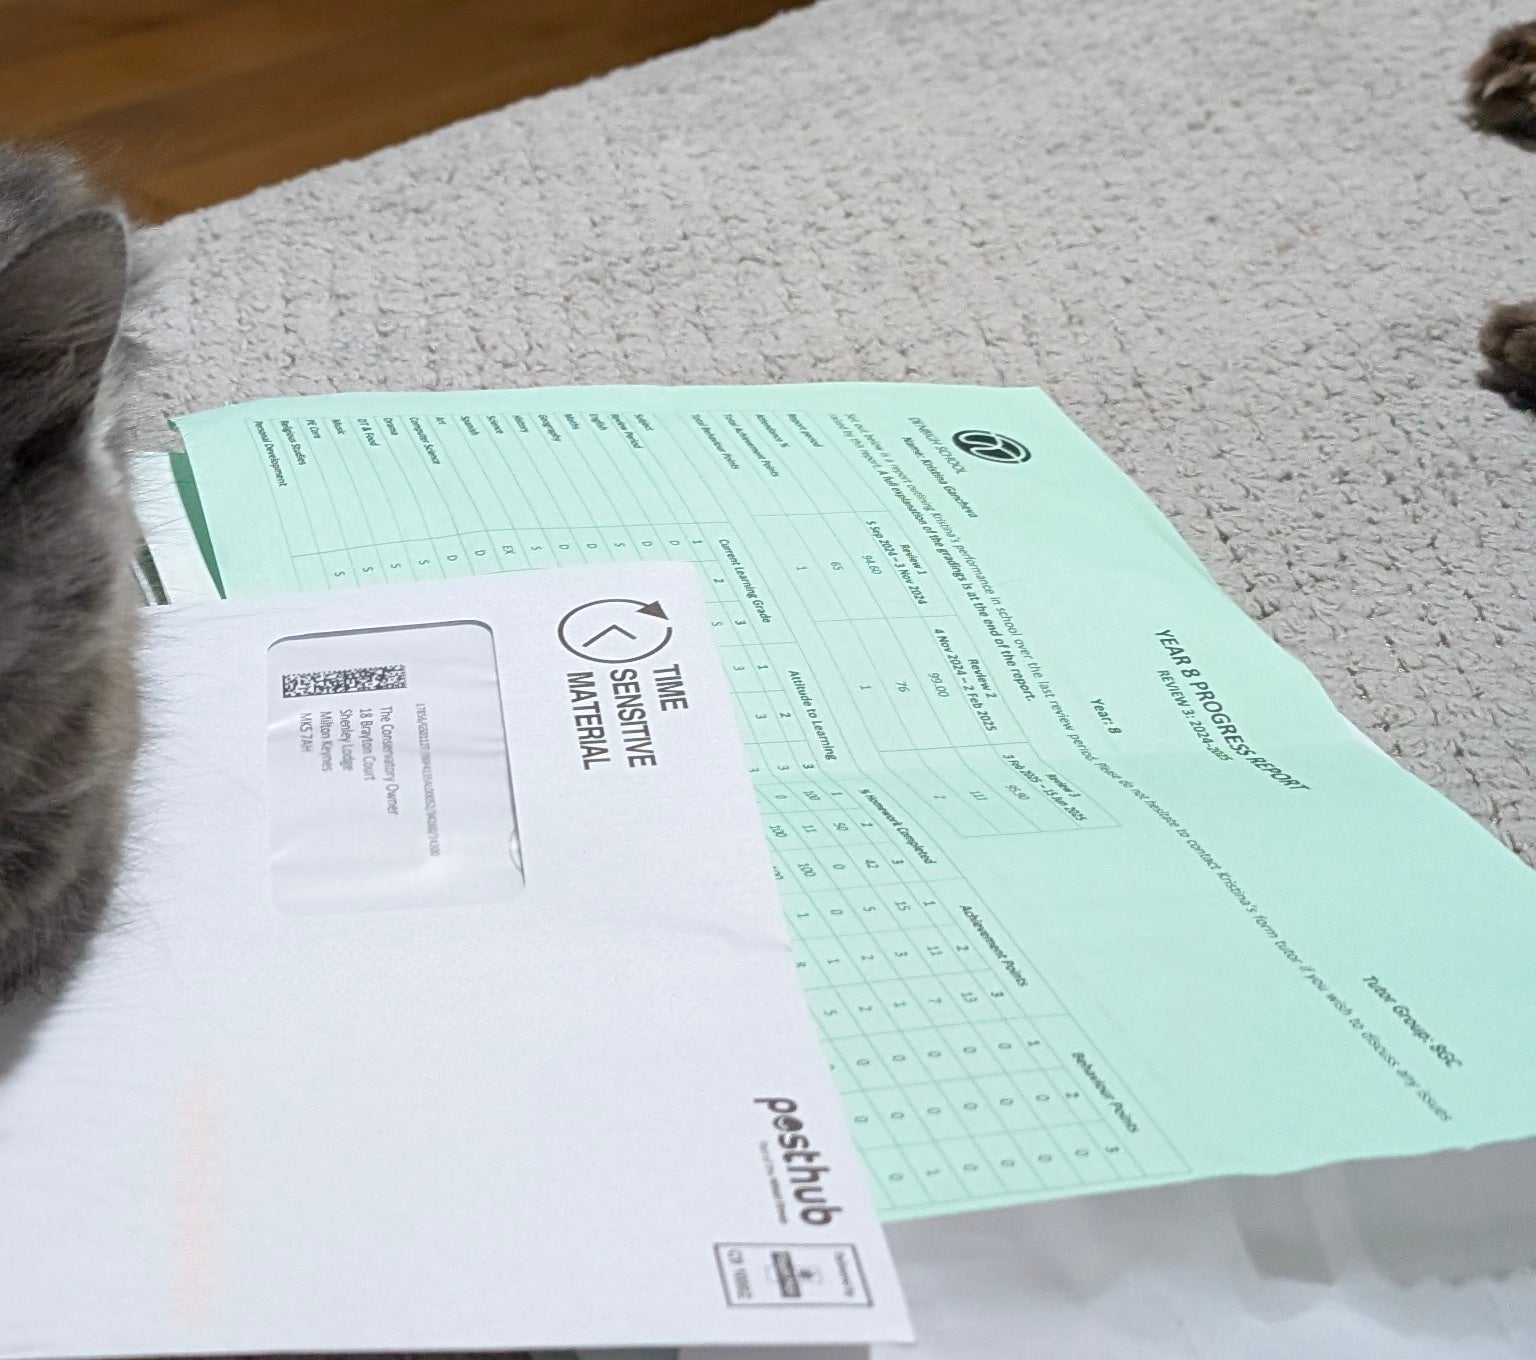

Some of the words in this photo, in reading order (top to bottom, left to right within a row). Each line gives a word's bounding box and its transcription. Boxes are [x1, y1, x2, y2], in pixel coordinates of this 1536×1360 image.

[718, 539, 742, 566] Current
[733, 566, 758, 600] Learning
[751, 599, 772, 624] Grade
[974, 601, 989, 618] the
[984, 619, 1003, 637] end
[994, 638, 1011, 650] of
[1001, 650, 1016, 668] the
[1154, 629, 1192, 666] YEAR
[652, 663, 689, 712] TIME
[937, 635, 954, 654] Nov
[947, 654, 967, 676] 2024
[967, 692, 984, 709] Feb
[977, 710, 998, 731] 2025
[968, 658, 994, 691] Review
[1180, 668, 1201, 678] 8
[1156, 670, 1191, 707] REVIEW
[1181, 709, 1195, 719] 3:
[319, 711, 334, 742] Milton
[359, 708, 373, 719] 18
[379, 706, 394, 722] The
[566, 671, 612, 770] MATERIAL
[609, 668, 658, 768] SENSITIVE
[787, 670, 814, 707] Attitude
[805, 708, 818, 719] to
[812, 720, 838, 761] Learning
[1090, 698, 1114, 725] Year:
[1188, 681, 1257, 756] PROGRESS
[363, 755, 376, 782] Court
[381, 723, 396, 782] Conservatory
[953, 543, 995, 596] performance
[996, 607, 1023, 636] school
[1014, 639, 1034, 661] over
[1027, 661, 1044, 679] the
[1038, 680, 1055, 698] last
[1049, 701, 1075, 731] review
[1144, 800, 1180, 827] hesitate
[1175, 828, 1191, 838] to
[1186, 840, 1222, 870] contact
[1253, 915, 1278, 938] form
[1274, 940, 1303, 964] tutor
[1245, 757, 1311, 790] REPORT
[384, 783, 400, 816] Owner
[753, 1097, 843, 1226] posthub
